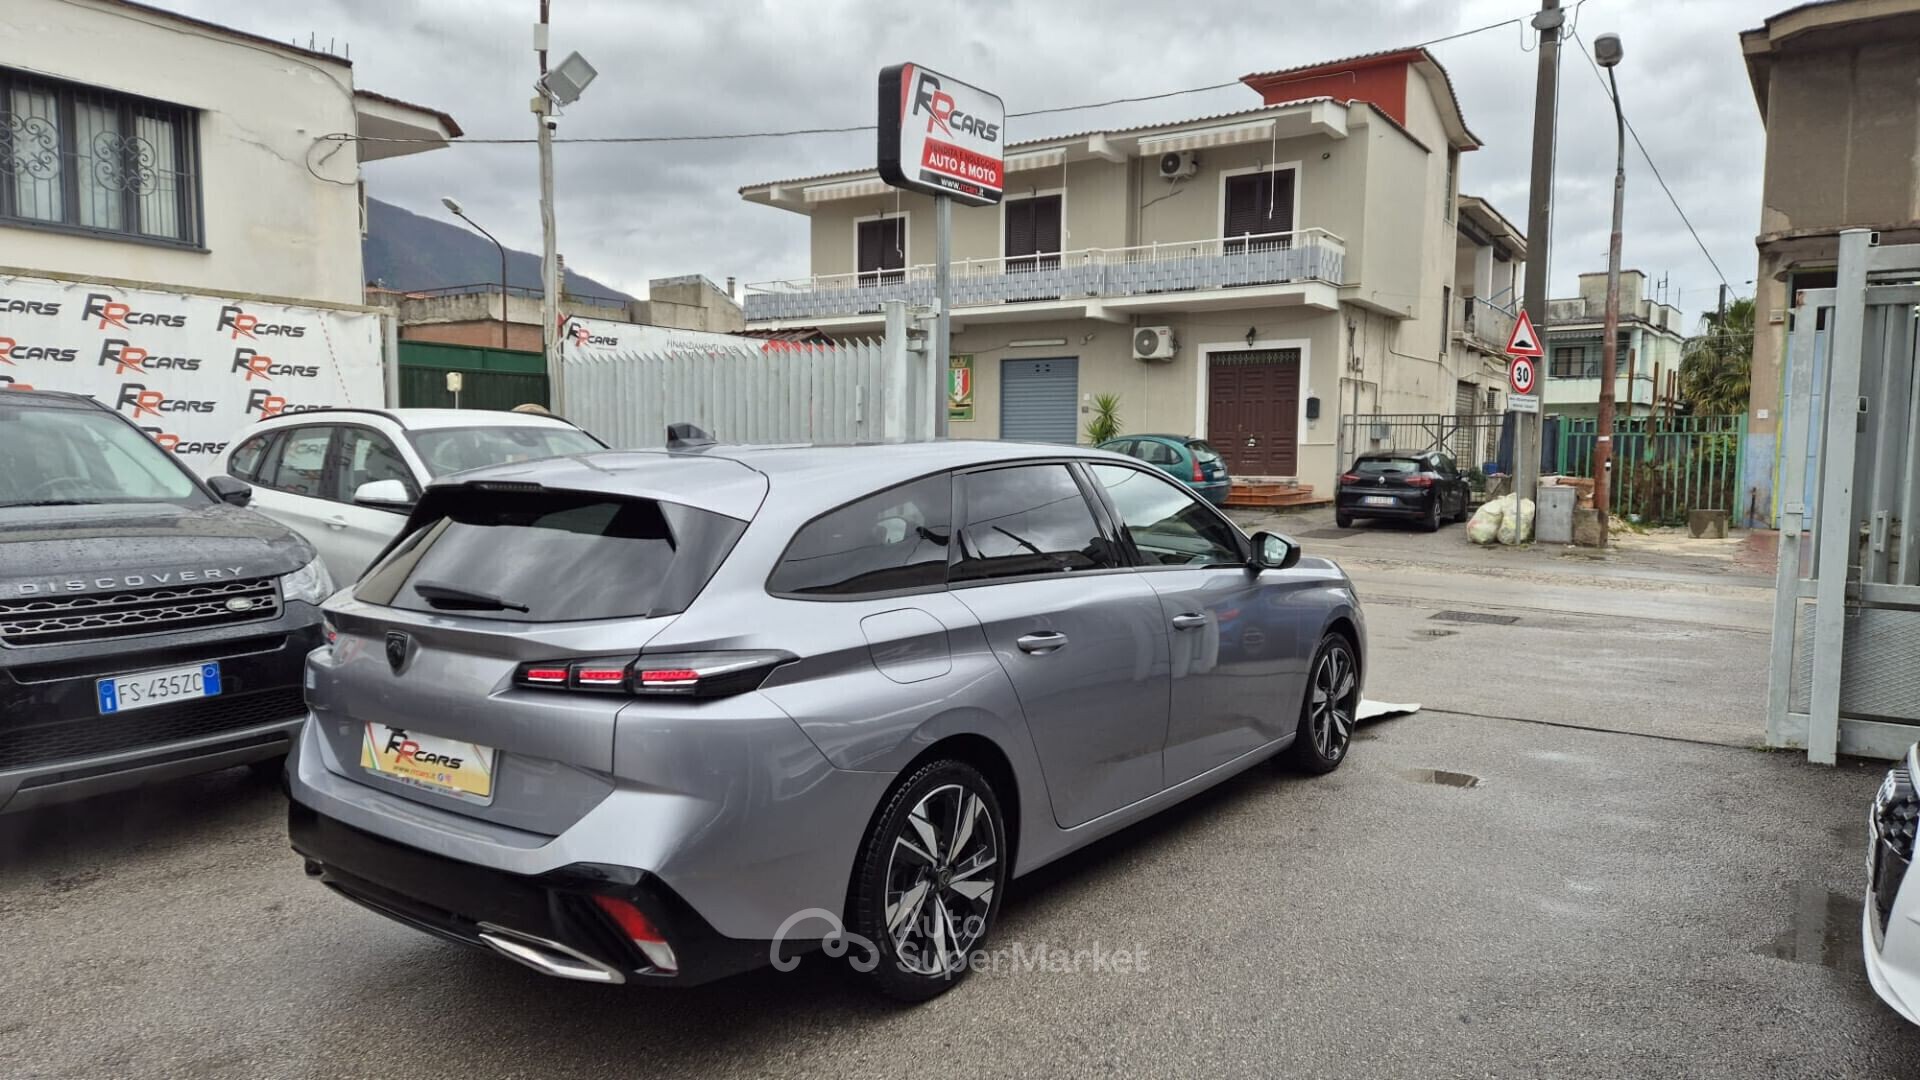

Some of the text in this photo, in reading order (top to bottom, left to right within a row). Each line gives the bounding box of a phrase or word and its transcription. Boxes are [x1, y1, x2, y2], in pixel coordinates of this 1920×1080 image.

[928, 151, 997, 183] AUTO & MOTO
[1516, 366, 1529, 383] 30
[18, 566, 243, 595] DISCOVERY
